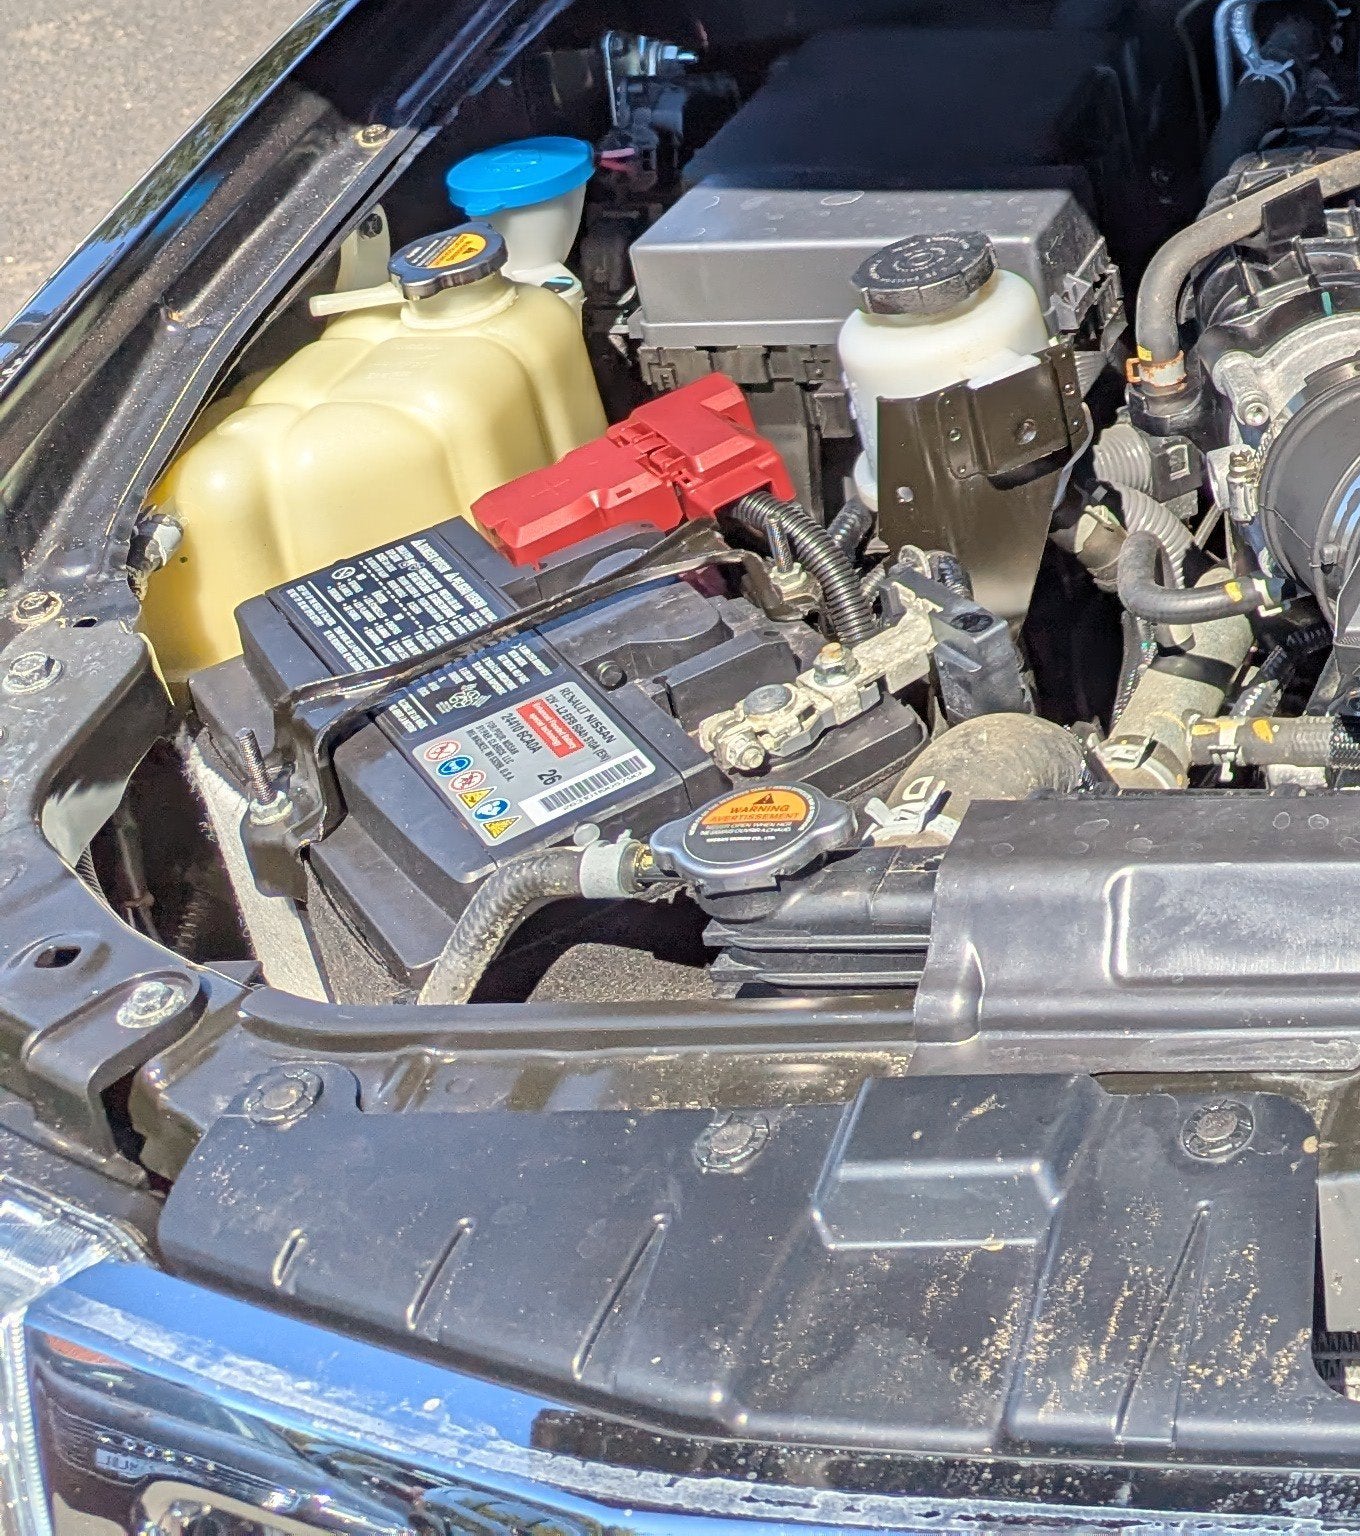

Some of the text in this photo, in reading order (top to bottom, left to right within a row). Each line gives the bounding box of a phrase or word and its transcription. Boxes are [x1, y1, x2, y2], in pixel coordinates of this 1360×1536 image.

[560, 687, 616, 744] RENAULT NISSAN
[537, 769, 562, 786] 26
[730, 804, 791, 814] WARNING
[710, 813, 799, 822] AVERTISSEMENT
